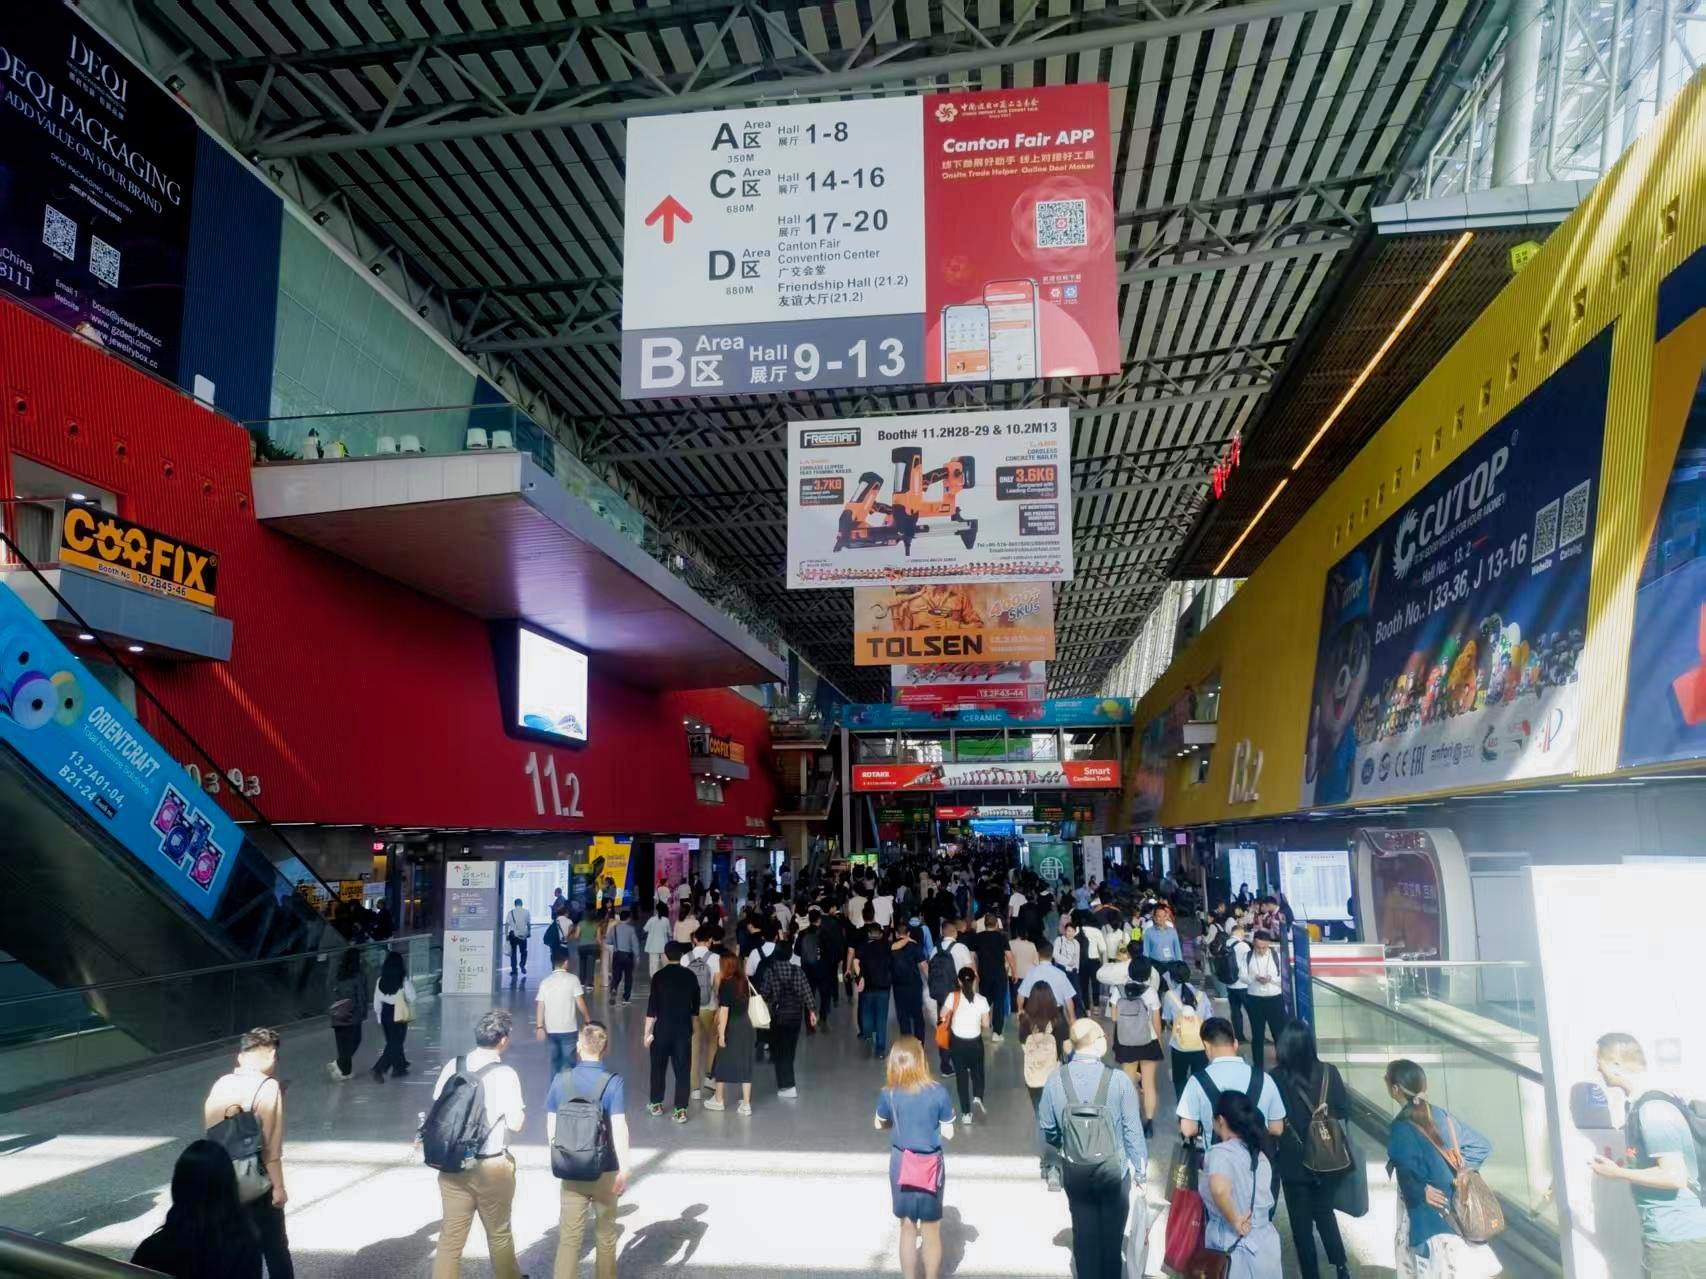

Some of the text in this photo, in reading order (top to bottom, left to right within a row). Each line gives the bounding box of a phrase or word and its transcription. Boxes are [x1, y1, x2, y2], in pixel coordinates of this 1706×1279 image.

[70, 33, 128, 103] DEQI
[711, 120, 771, 150] A Area
[743, 131, 761, 149] 区
[778, 122, 848, 144] Hall 1-8
[778, 136, 799, 146] 展厅
[943, 129, 1095, 153] Canton Fair APP
[4, 90, 34, 119] ADD
[36, 111, 75, 149] VALUE
[75, 143, 95, 165] ON
[97, 155, 127, 190] YOUR
[127, 181, 162, 214] BRAND
[60, 94, 181, 206] PACKAGING
[728, 154, 754, 163] 350M
[710, 167, 771, 198] C Area
[778, 167, 885, 192] Hall 14-16
[942, 162, 1095, 180] Onsite Trade Helper Online Deal Maker
[68, 164, 103, 194] PACKAGING
[104, 191, 133, 214] INDUSTRY
[742, 179, 761, 197] 区
[778, 184, 799, 194] 展厅
[726, 204, 754, 213] 680M
[778, 209, 888, 235] Hall 17-20
[778, 227, 800, 237] 展厅
[778, 238, 840, 251] Canton Fair
[709, 248, 771, 281] D Area
[778, 249, 880, 264] Convention Center
[741, 260, 760, 279] 区
[778, 265, 826, 277] 广交会堂
[56, 279, 73, 294] Email
[778, 275, 909, 292] Friendship Hall (21.2)
[54, 291, 79, 312] Website
[778, 292, 863, 306] 友谊大厅(21.2)
[92, 299, 162, 347] boss@jewelrybox.cc
[640, 334, 744, 390] B Area
[750, 337, 906, 381] Hall 9-13
[690, 355, 723, 388] 区
[750, 365, 787, 384] 展厅
[804, 430, 857, 447] FREEMAN
[878, 422, 1057, 441] Booth# 11.2H28-29 & 10.2M13
[1016, 467, 1054, 482] 3.6KG
[1419, 446, 1509, 546] CUTOP
[64, 507, 209, 592] COOFIX
[98, 563, 119, 575] Booth
[138, 573, 186, 596] 10.2B45-46
[1375, 611, 1403, 645] Booth
[1473, 569, 1483, 589] J
[1487, 533, 1527, 580] 13-16
[866, 634, 982, 658] TOLSEN
[963, 714, 1002, 722] CERAMIC
[88, 706, 160, 778] ORIENTCRAFT
[69, 751, 124, 808] 13.2A01-04,
[1084, 767, 1110, 775] Smart
[58, 765, 97, 801] B21-24
[525, 752, 584, 817] 11.2
